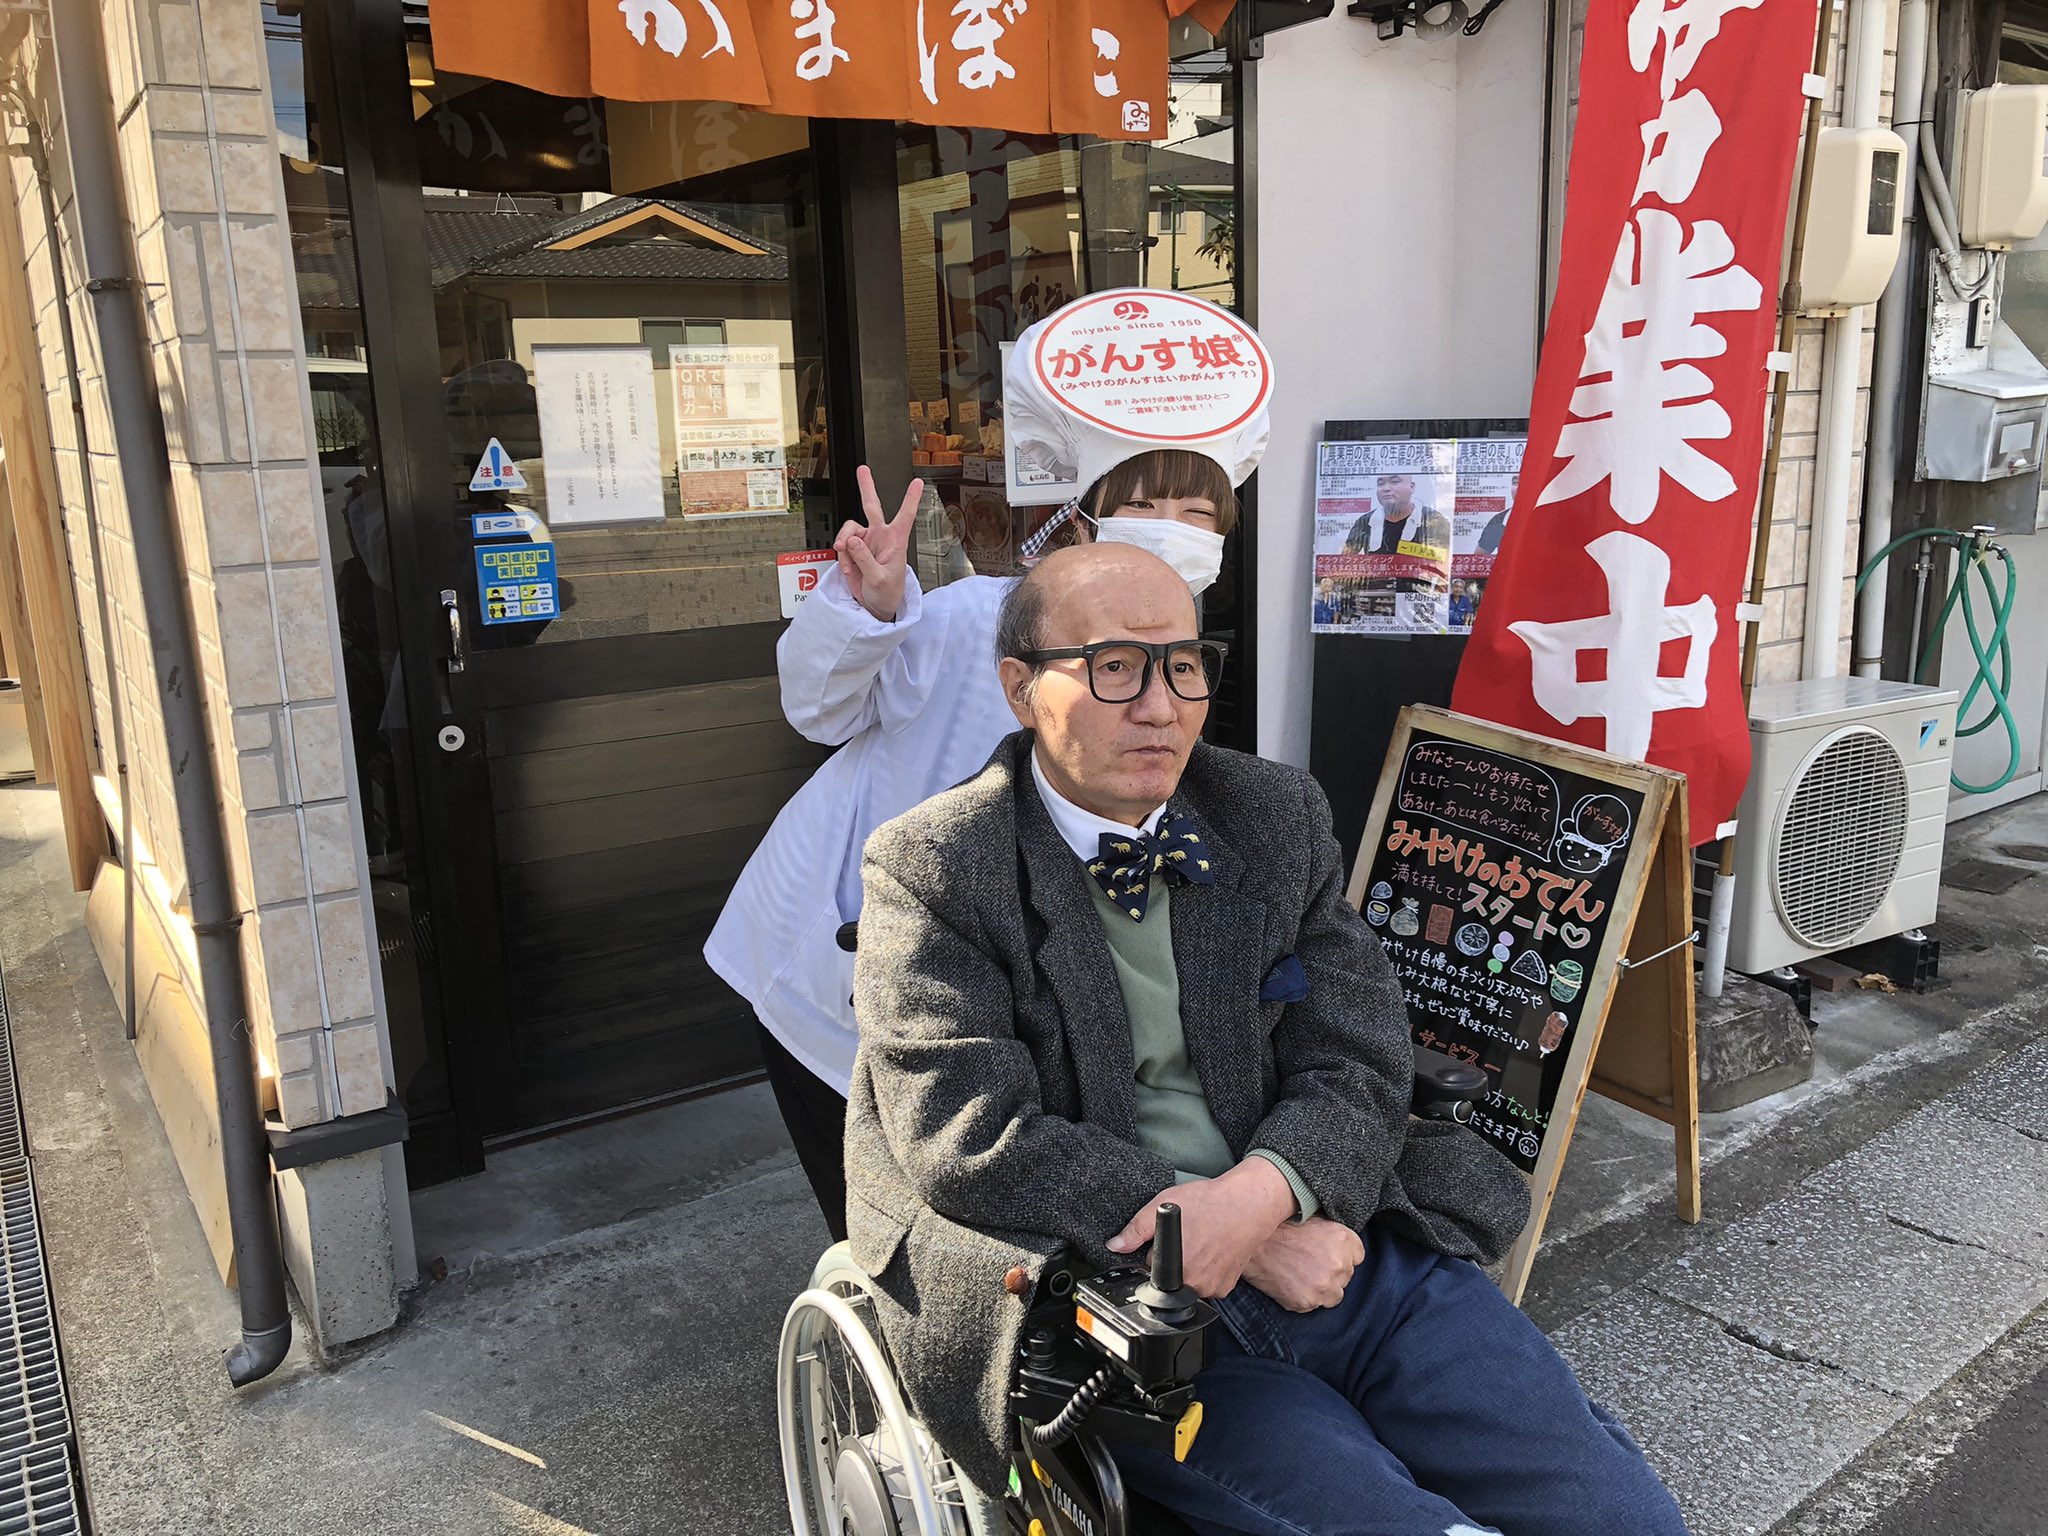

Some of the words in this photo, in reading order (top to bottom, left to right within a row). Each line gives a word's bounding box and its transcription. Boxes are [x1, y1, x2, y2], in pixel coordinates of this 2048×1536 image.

[1071, 323, 1121, 337] miyake
[1126, 320, 1165, 331] since
[1169, 317, 1202, 328] 1950
[680, 368, 721, 384] QRで
[1508, 0, 1765, 762] 営業中
[683, 400, 722, 415] ガード
[752, 450, 776, 463] 完了
[1386, 820, 1605, 923] みやけのおでん
[1461, 881, 1558, 941] スタート
[1050, 1477, 1095, 1536] YAMAHA
